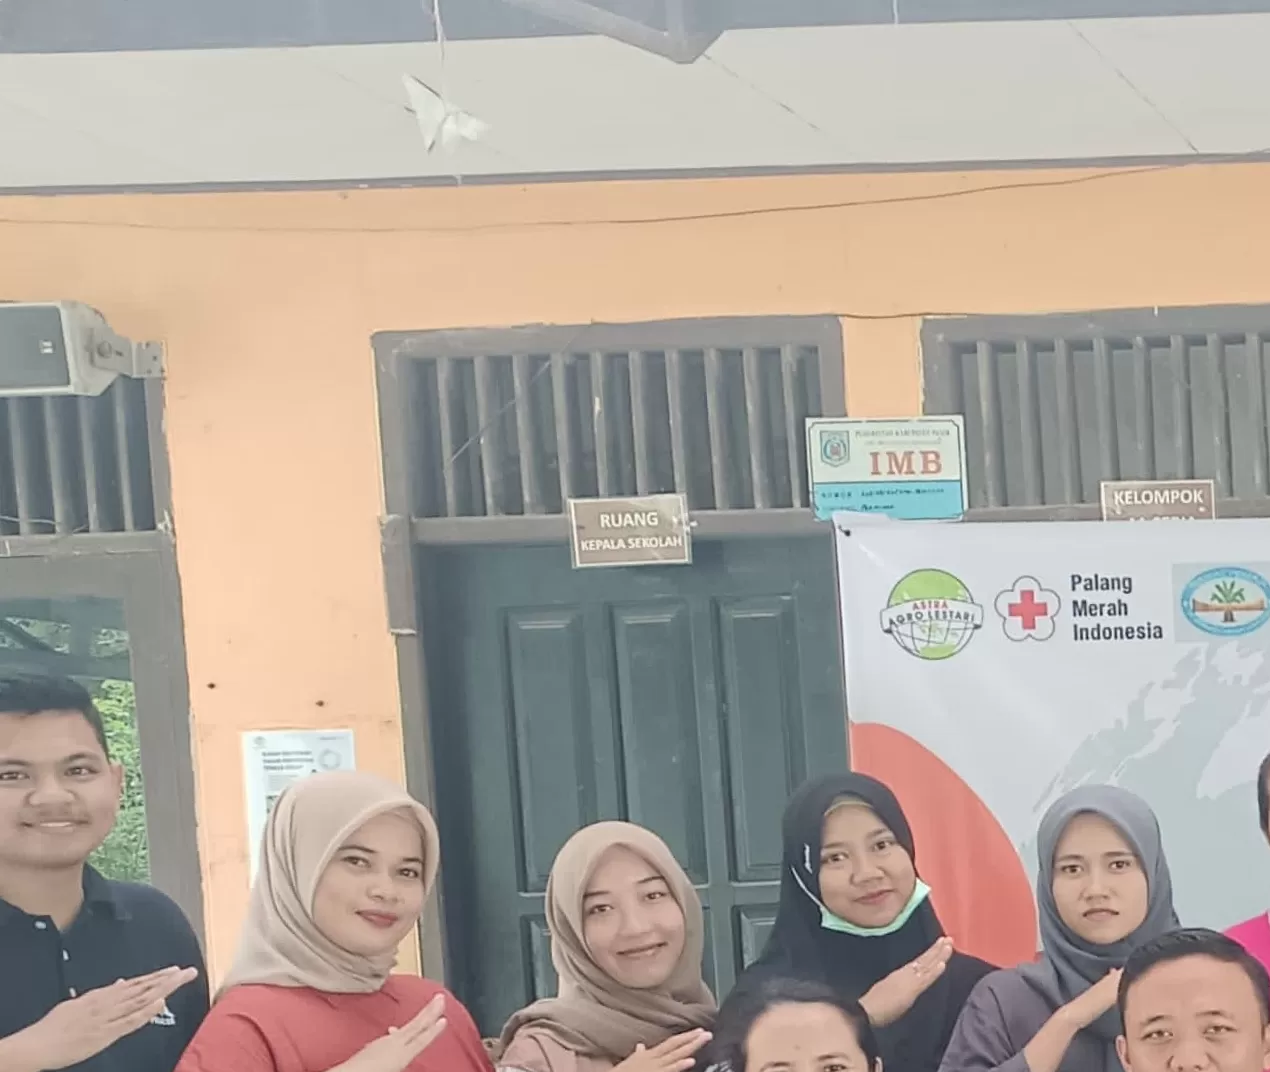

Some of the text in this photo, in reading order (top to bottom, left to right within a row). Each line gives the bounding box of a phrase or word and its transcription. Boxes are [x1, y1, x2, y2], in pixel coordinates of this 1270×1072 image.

[869, 450, 943, 476] IMB
[1113, 489, 1204, 506] KELOMPOK
[599, 511, 659, 528] RUANG
[580, 536, 683, 551] KEPALA SEKOLAH
[1070, 573, 1133, 594] Palang
[912, 600, 949, 611] ASTRA
[1072, 600, 1128, 618] Merah
[888, 610, 975, 628] AGRO LESTARI
[1073, 622, 1163, 641] Indonesia
